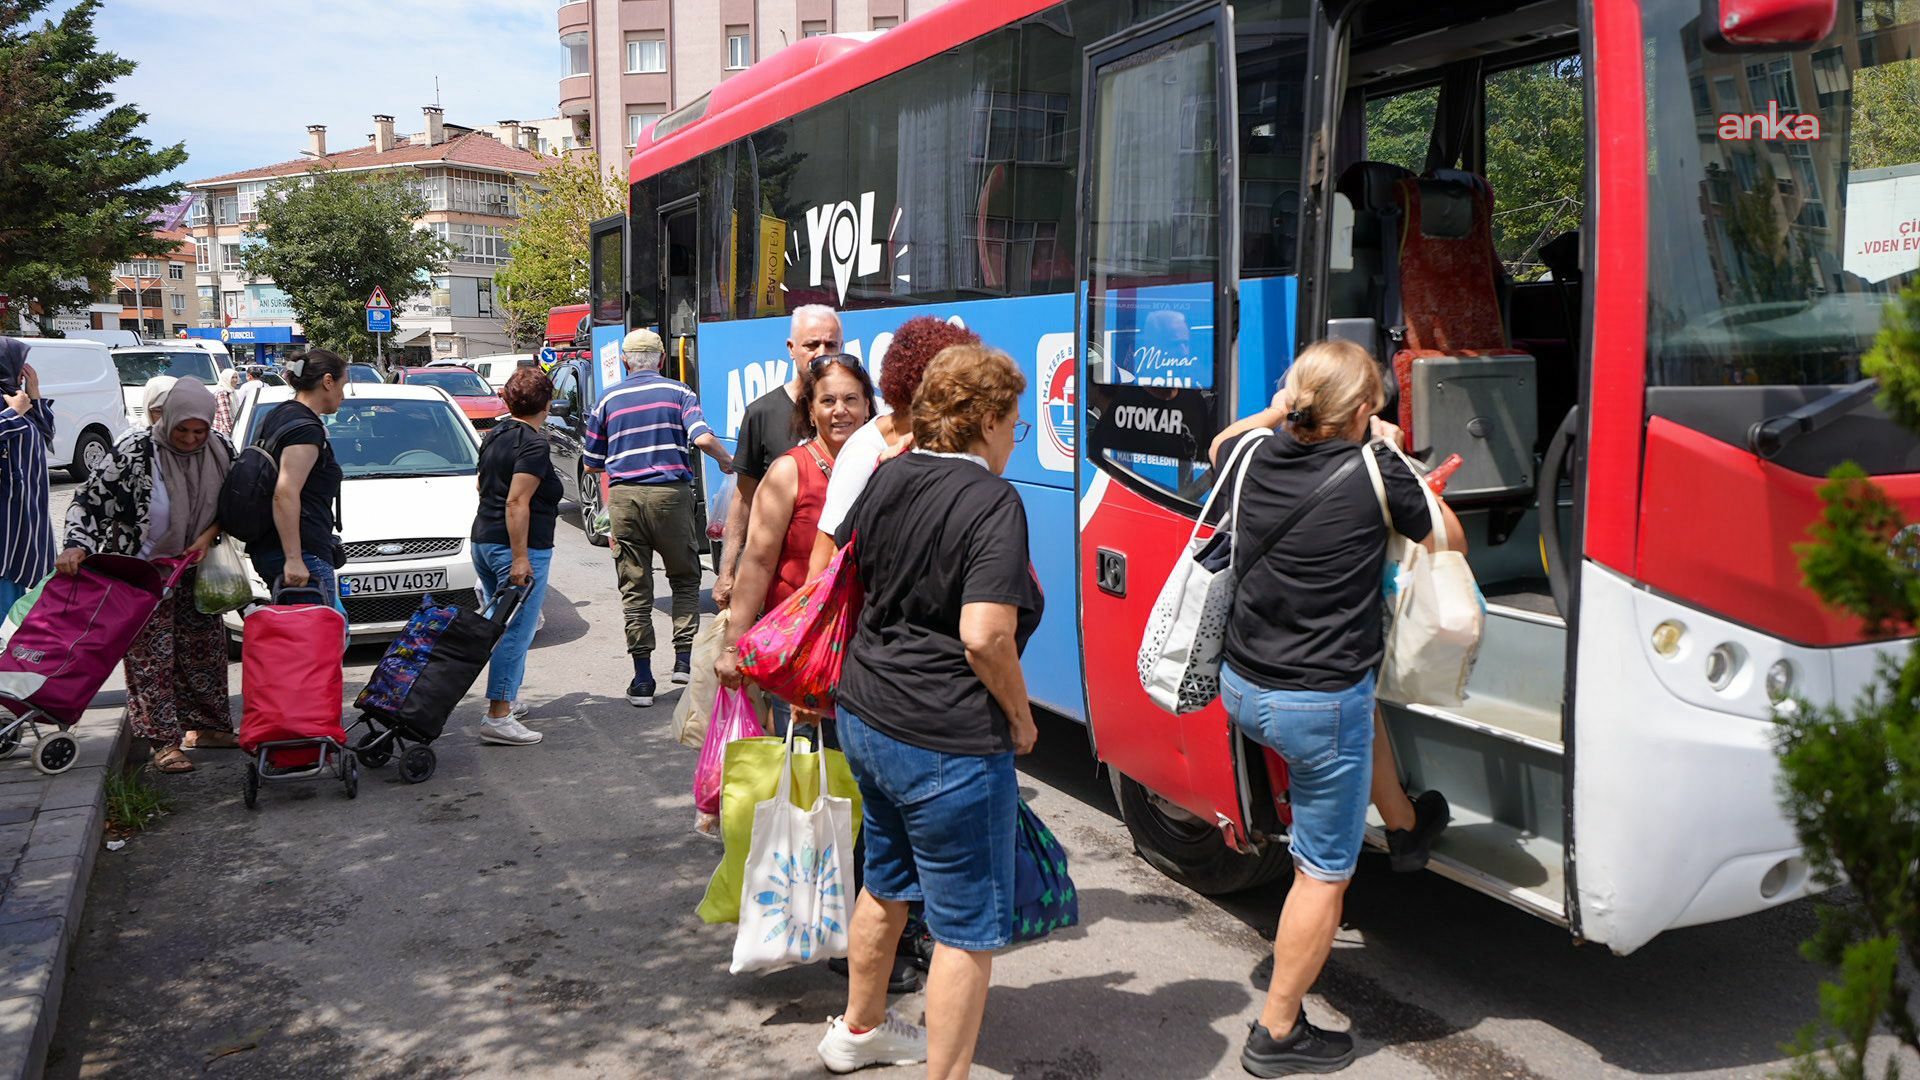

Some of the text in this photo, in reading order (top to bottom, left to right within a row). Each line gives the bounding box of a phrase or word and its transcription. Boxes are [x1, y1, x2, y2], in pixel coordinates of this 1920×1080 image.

[1899, 218, 1920, 236] Çİ
[805, 191, 882, 306] YOL
[1857, 239, 1900, 254] VDEN
[1133, 346, 1198, 373] Mimar
[1042, 349, 1066, 398] MALTEPE
[1114, 405, 1183, 435] OTOKAR
[1117, 451, 1147, 464] MALTEPE
[350, 577, 372, 593] 34
[374, 575, 400, 592] DV
[403, 572, 444, 589] 4037
